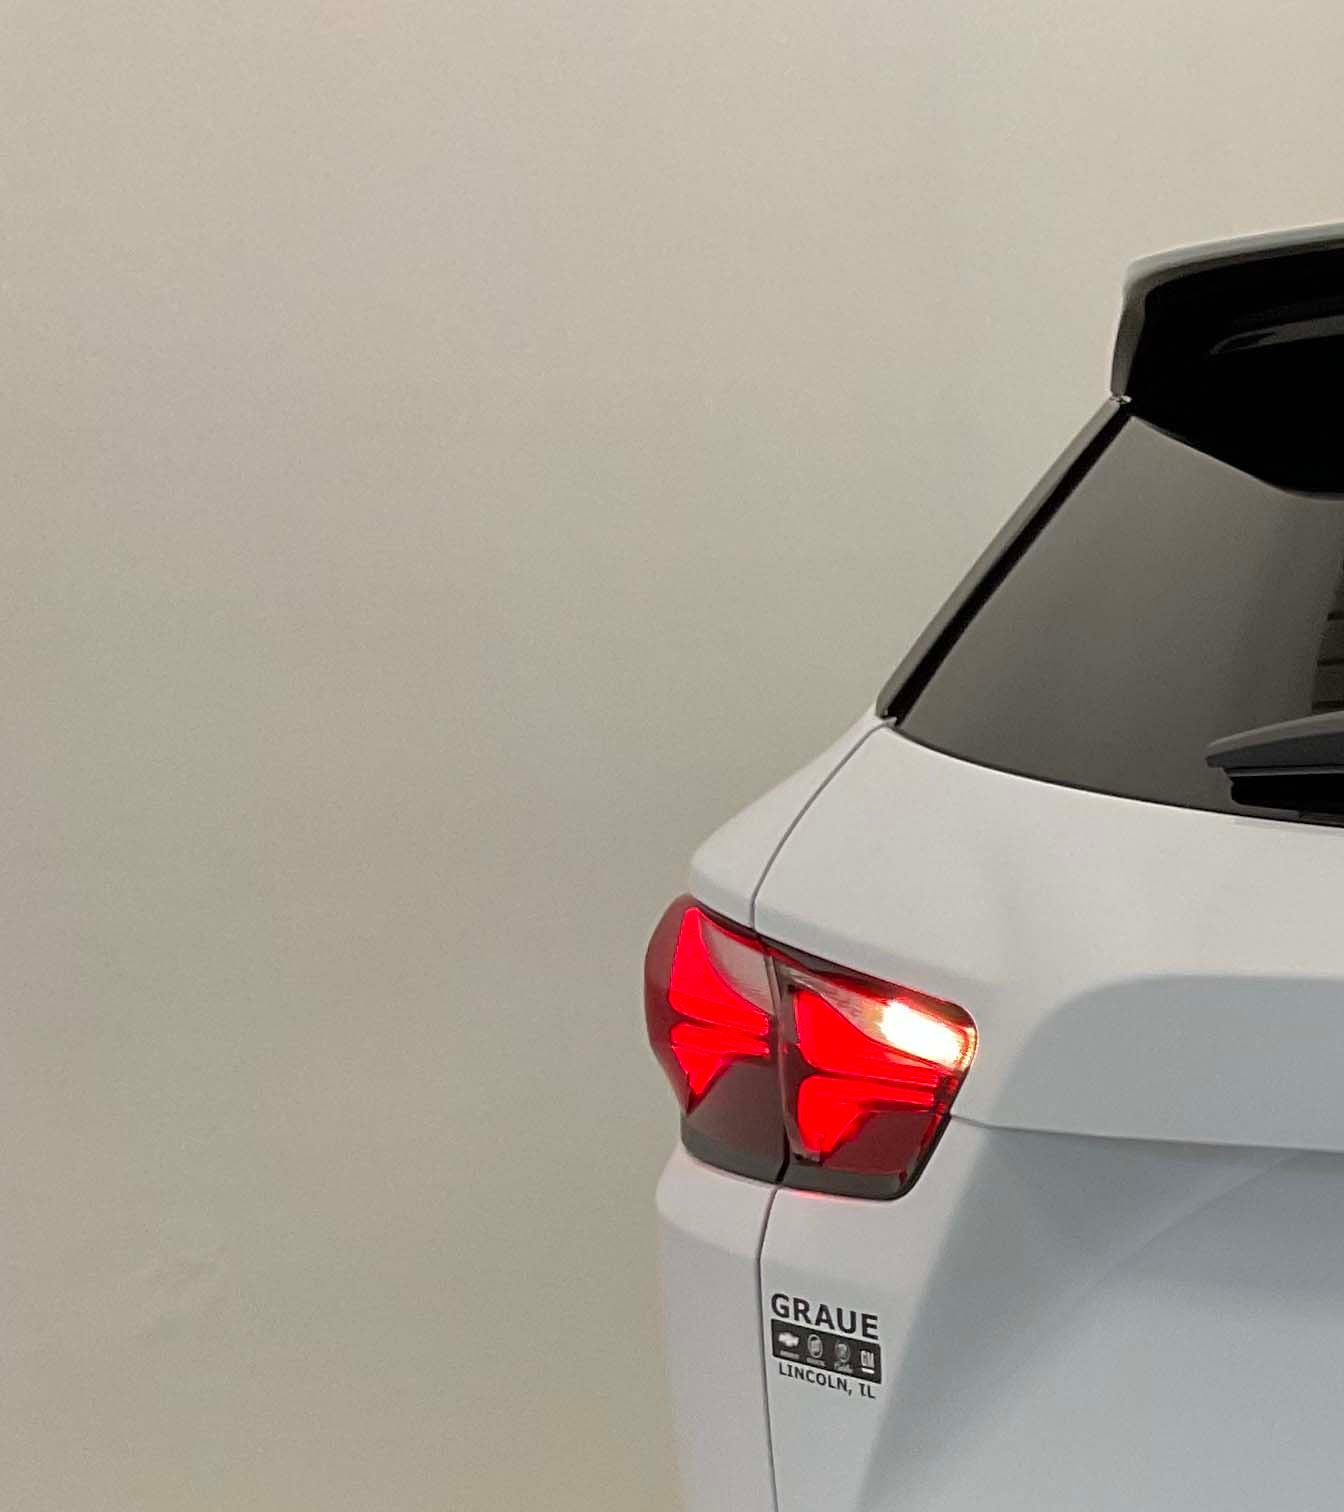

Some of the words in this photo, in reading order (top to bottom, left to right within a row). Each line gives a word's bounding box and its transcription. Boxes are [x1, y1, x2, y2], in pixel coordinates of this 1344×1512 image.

[770, 1293, 879, 1340] GRAUE
[778, 1362, 853, 1396] LINCOLN,
[858, 1382, 876, 1399] IL
